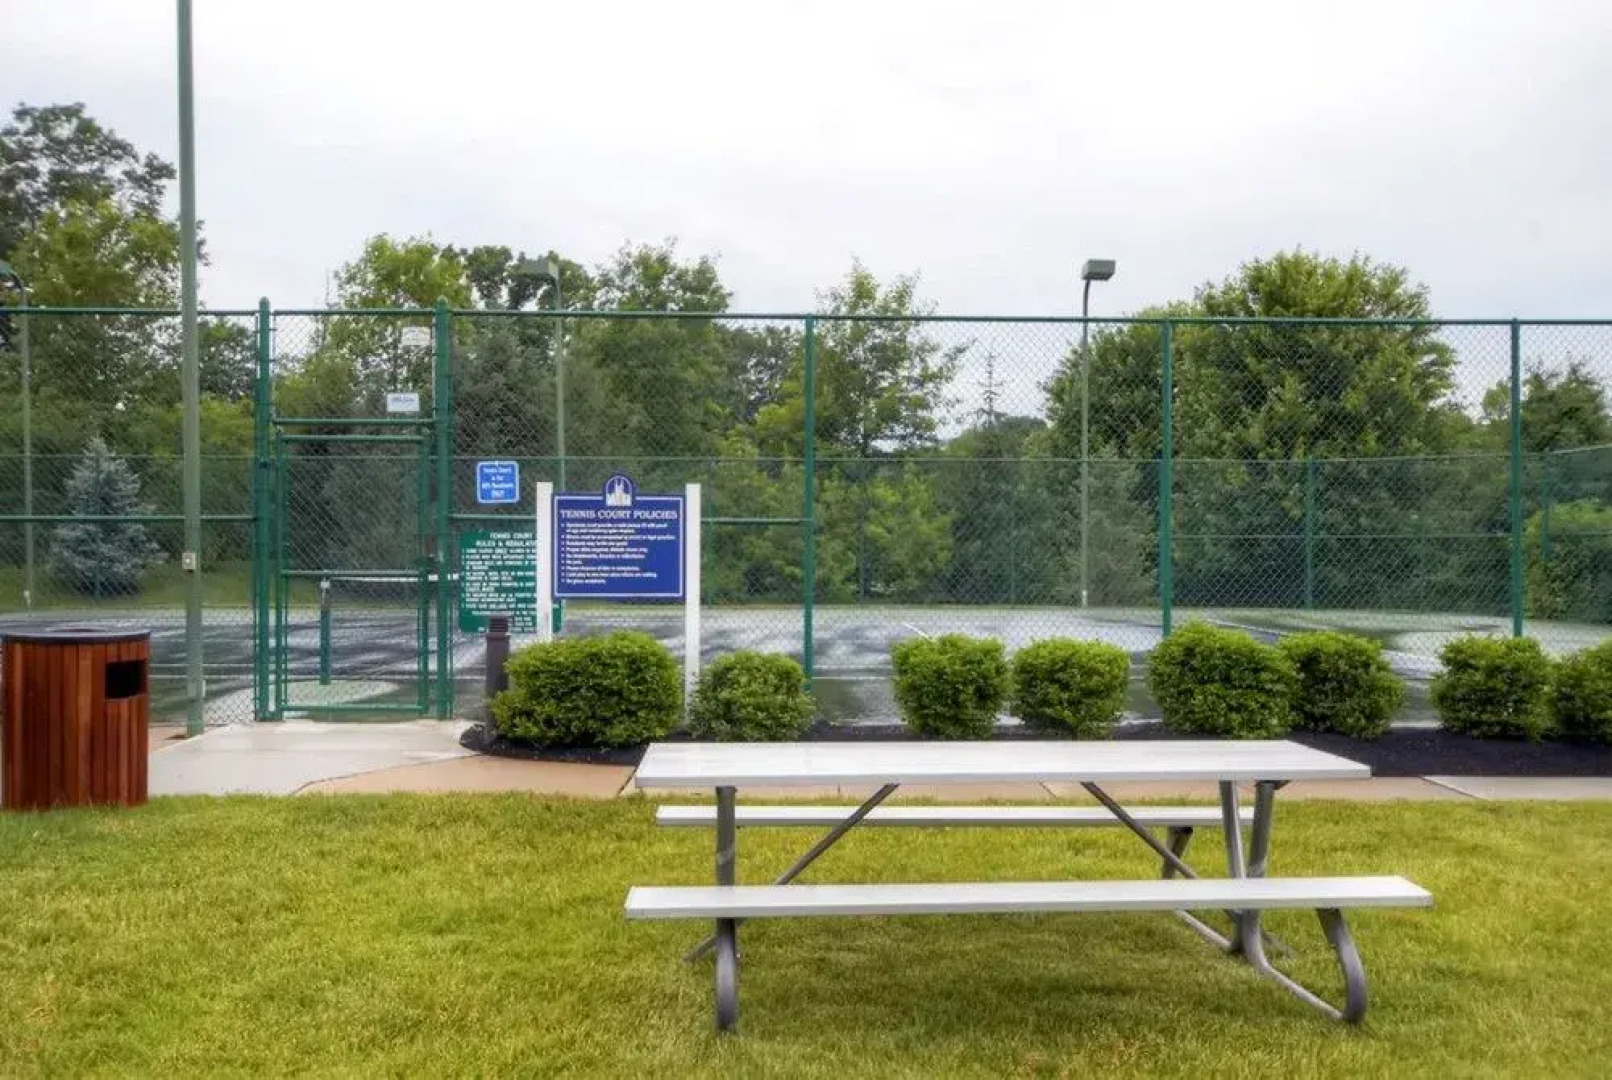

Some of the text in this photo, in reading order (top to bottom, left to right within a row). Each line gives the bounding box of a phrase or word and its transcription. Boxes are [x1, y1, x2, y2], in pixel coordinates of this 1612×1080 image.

[560, 510, 678, 519] TENNIS COURT POLICIES
